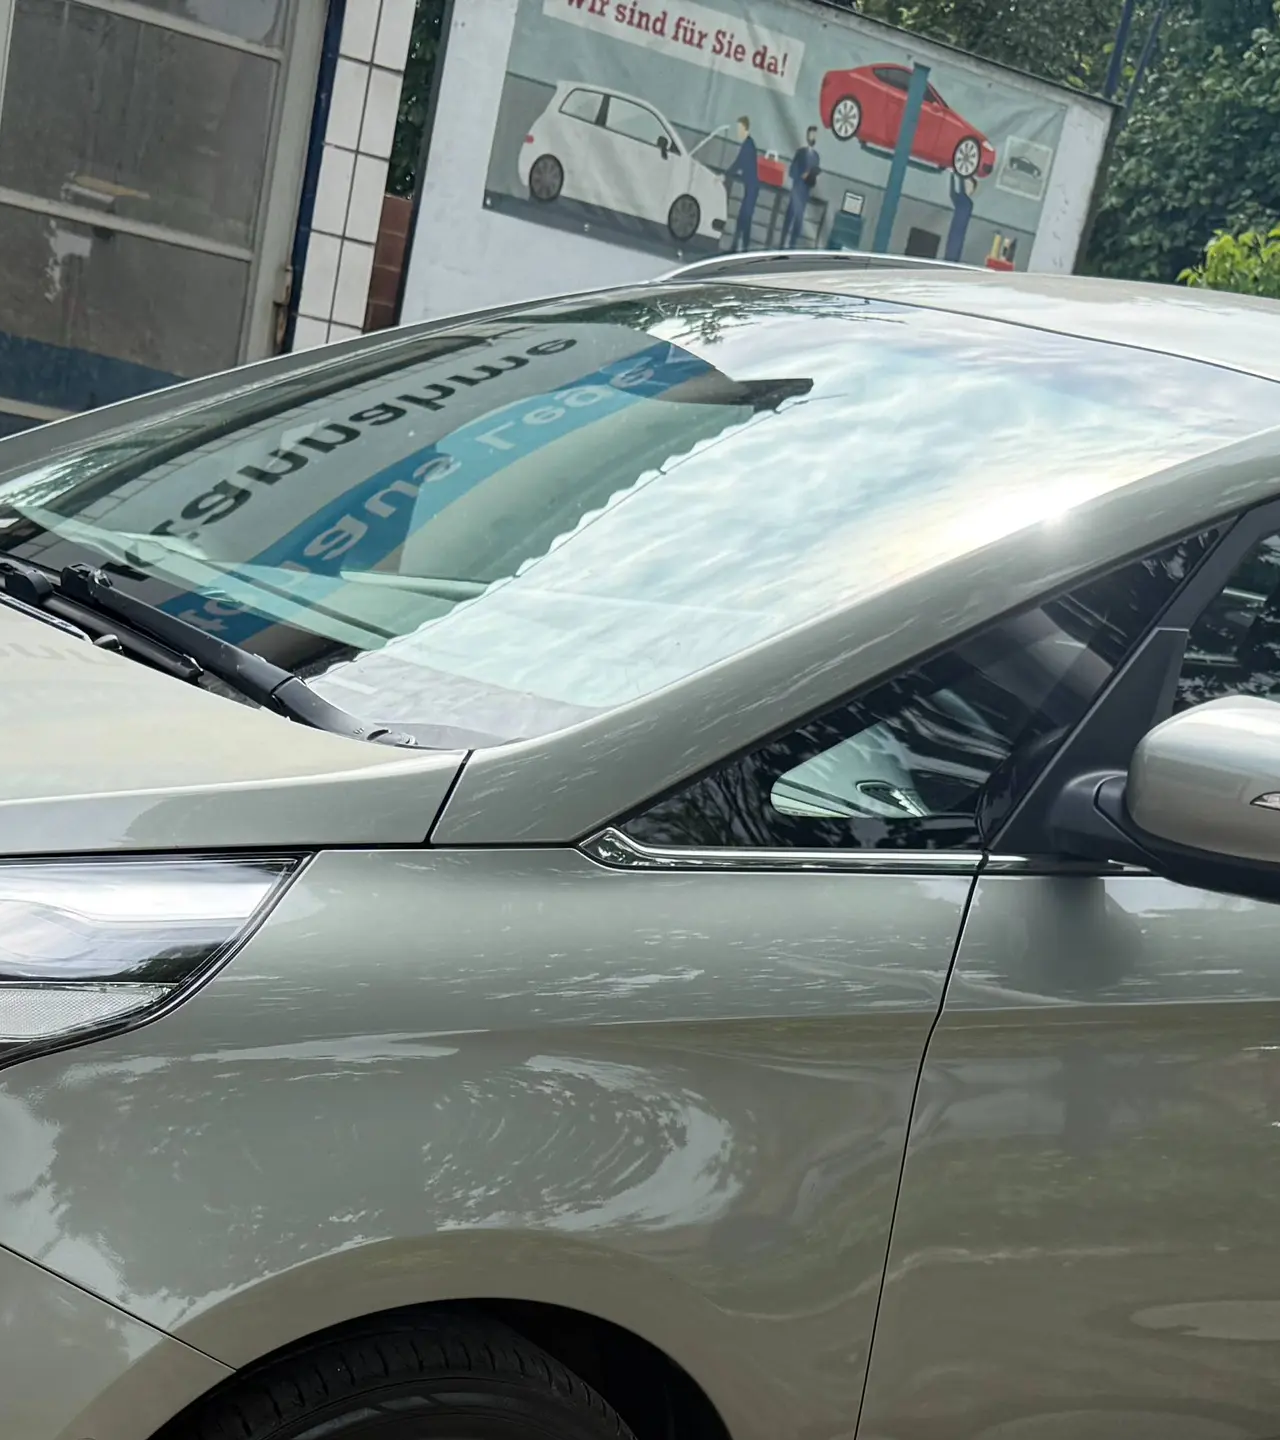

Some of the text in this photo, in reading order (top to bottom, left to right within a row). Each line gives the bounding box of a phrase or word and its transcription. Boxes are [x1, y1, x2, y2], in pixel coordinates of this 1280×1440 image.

[614, 1, 668, 37] sind
[671, 17, 708, 51] für
[711, 29, 746, 63] Sie
[751, 45, 788, 77] da!
